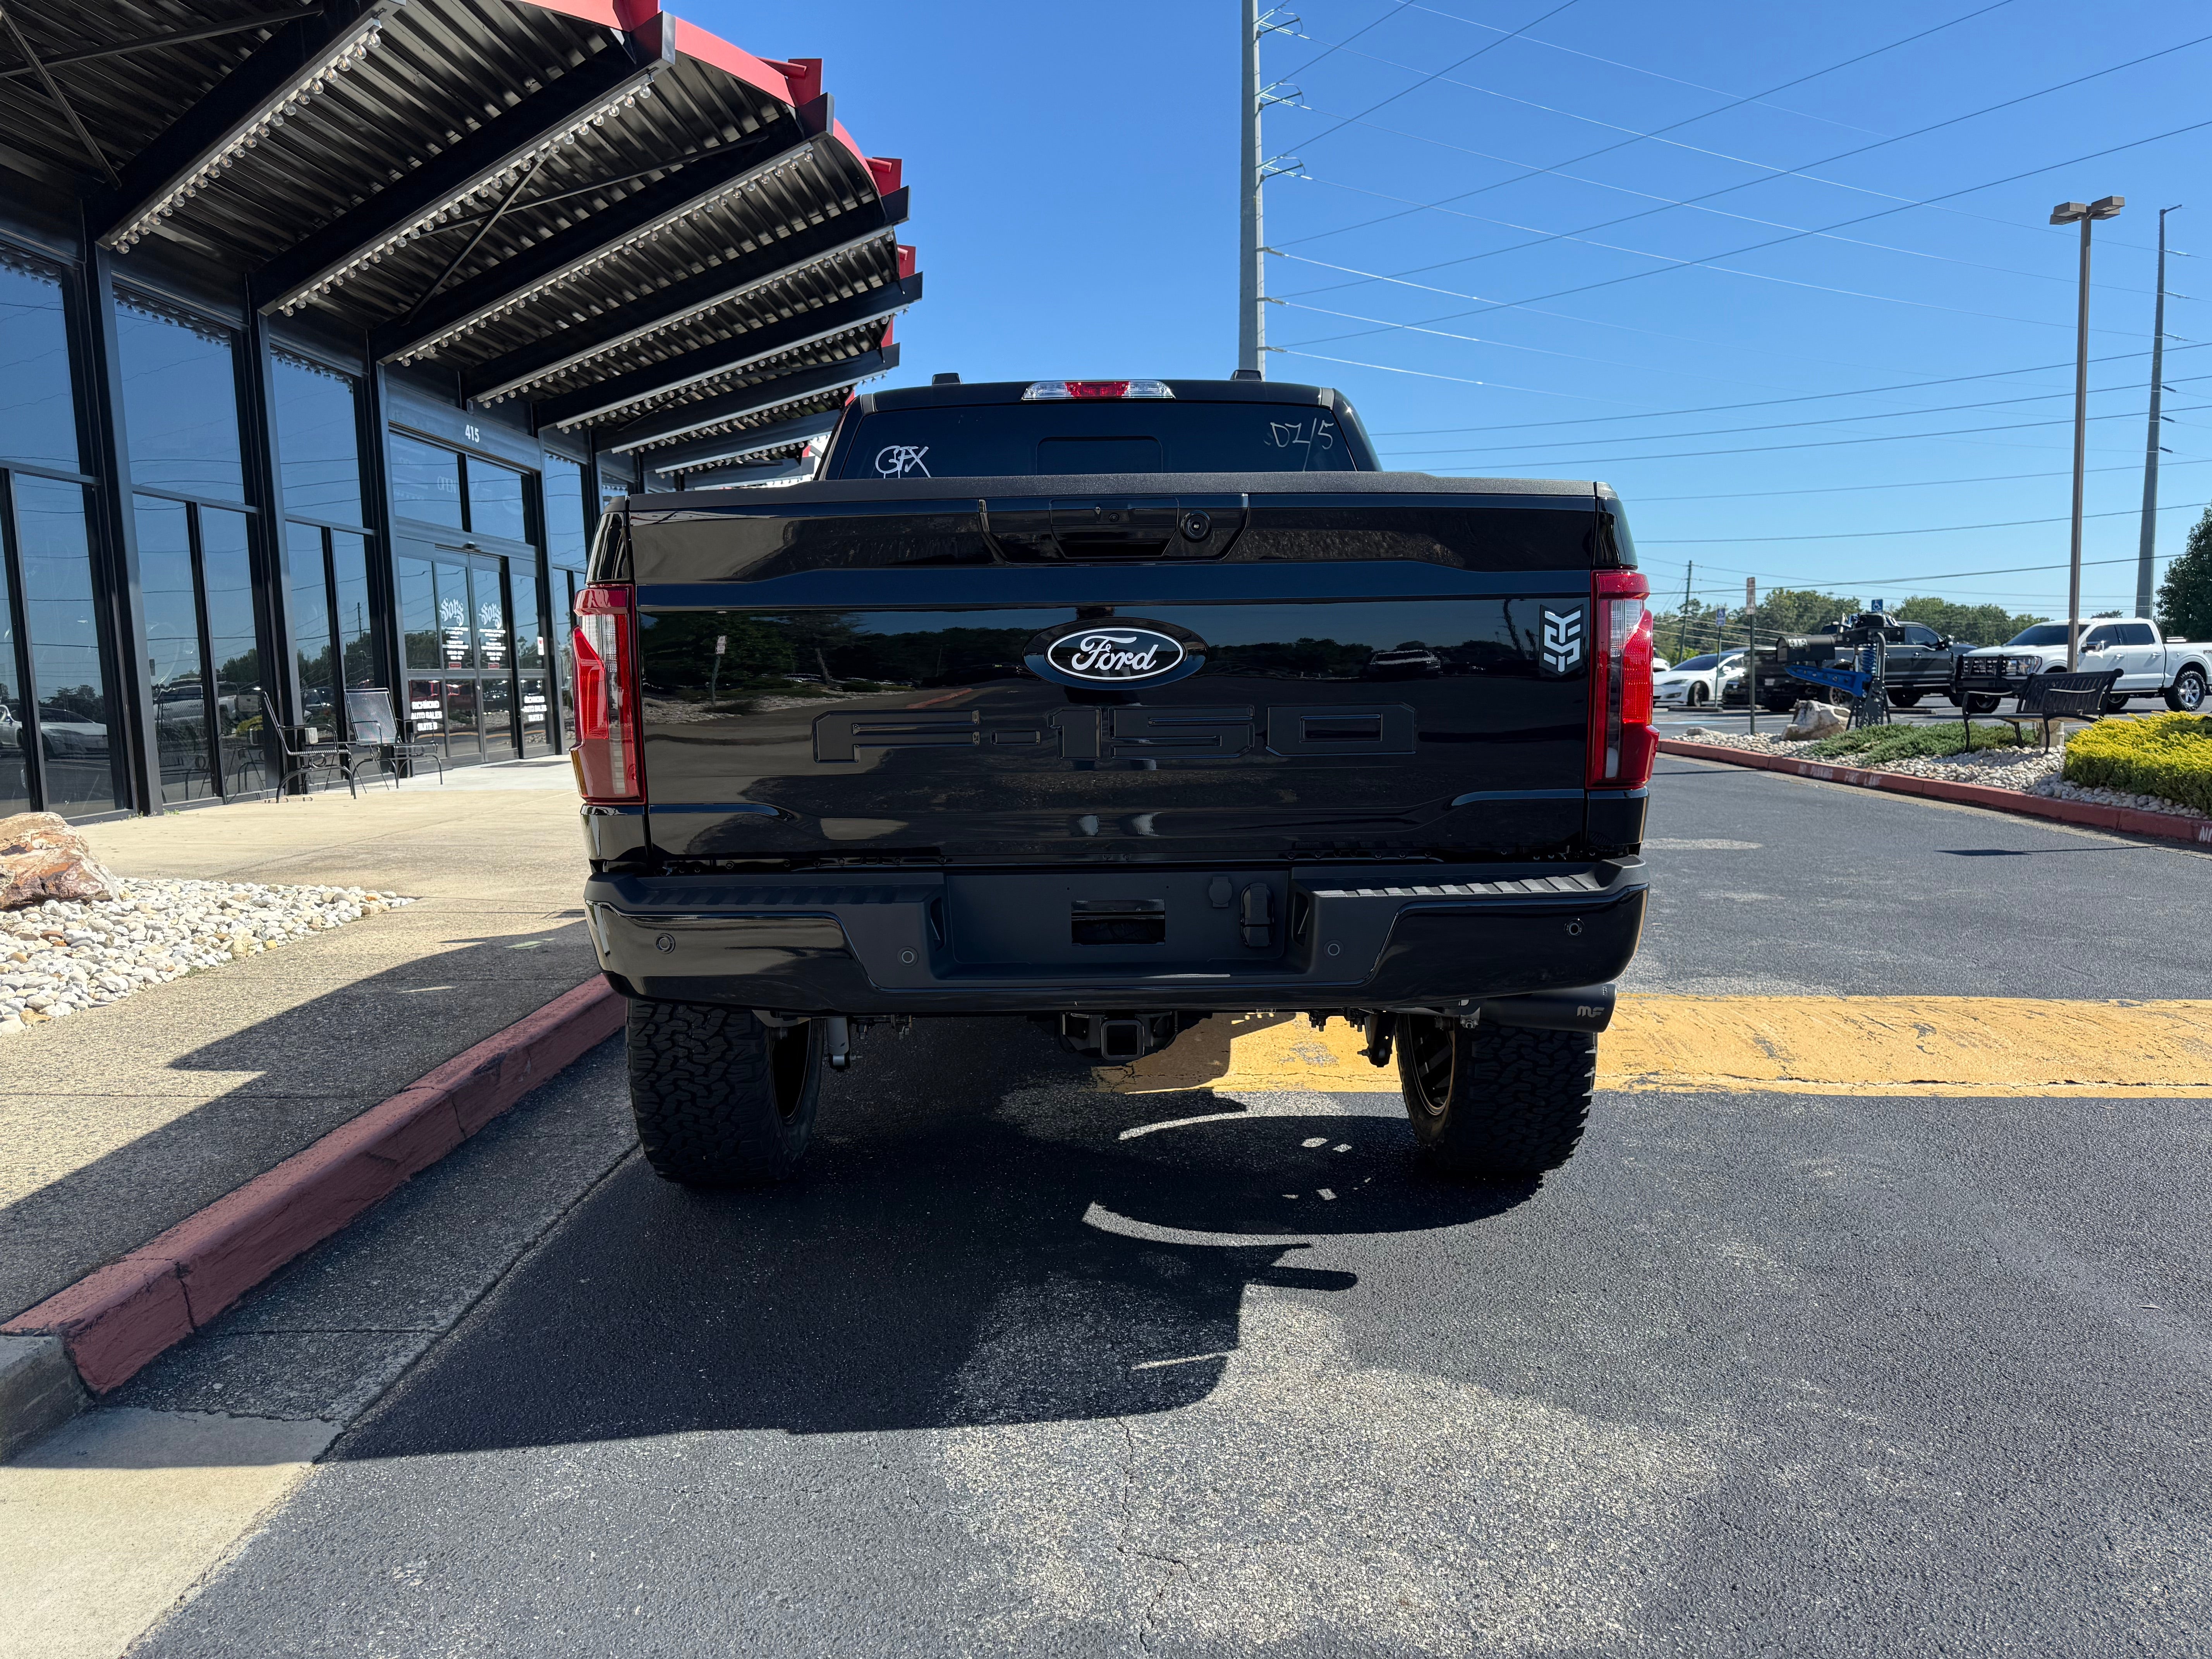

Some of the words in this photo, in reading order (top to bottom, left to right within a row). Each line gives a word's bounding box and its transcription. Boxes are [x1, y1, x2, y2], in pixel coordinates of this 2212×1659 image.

[465, 424, 480, 443] 415
[437, 476, 457, 494] OPEN
[1071, 635, 1159, 670] Ford
[412, 701, 440, 709] RICHMOND
[411, 712, 426, 720] AUTO
[426, 711, 442, 719] SALES
[417, 722, 433, 731] SUITE
[813, 702, 1417, 763] F-150
